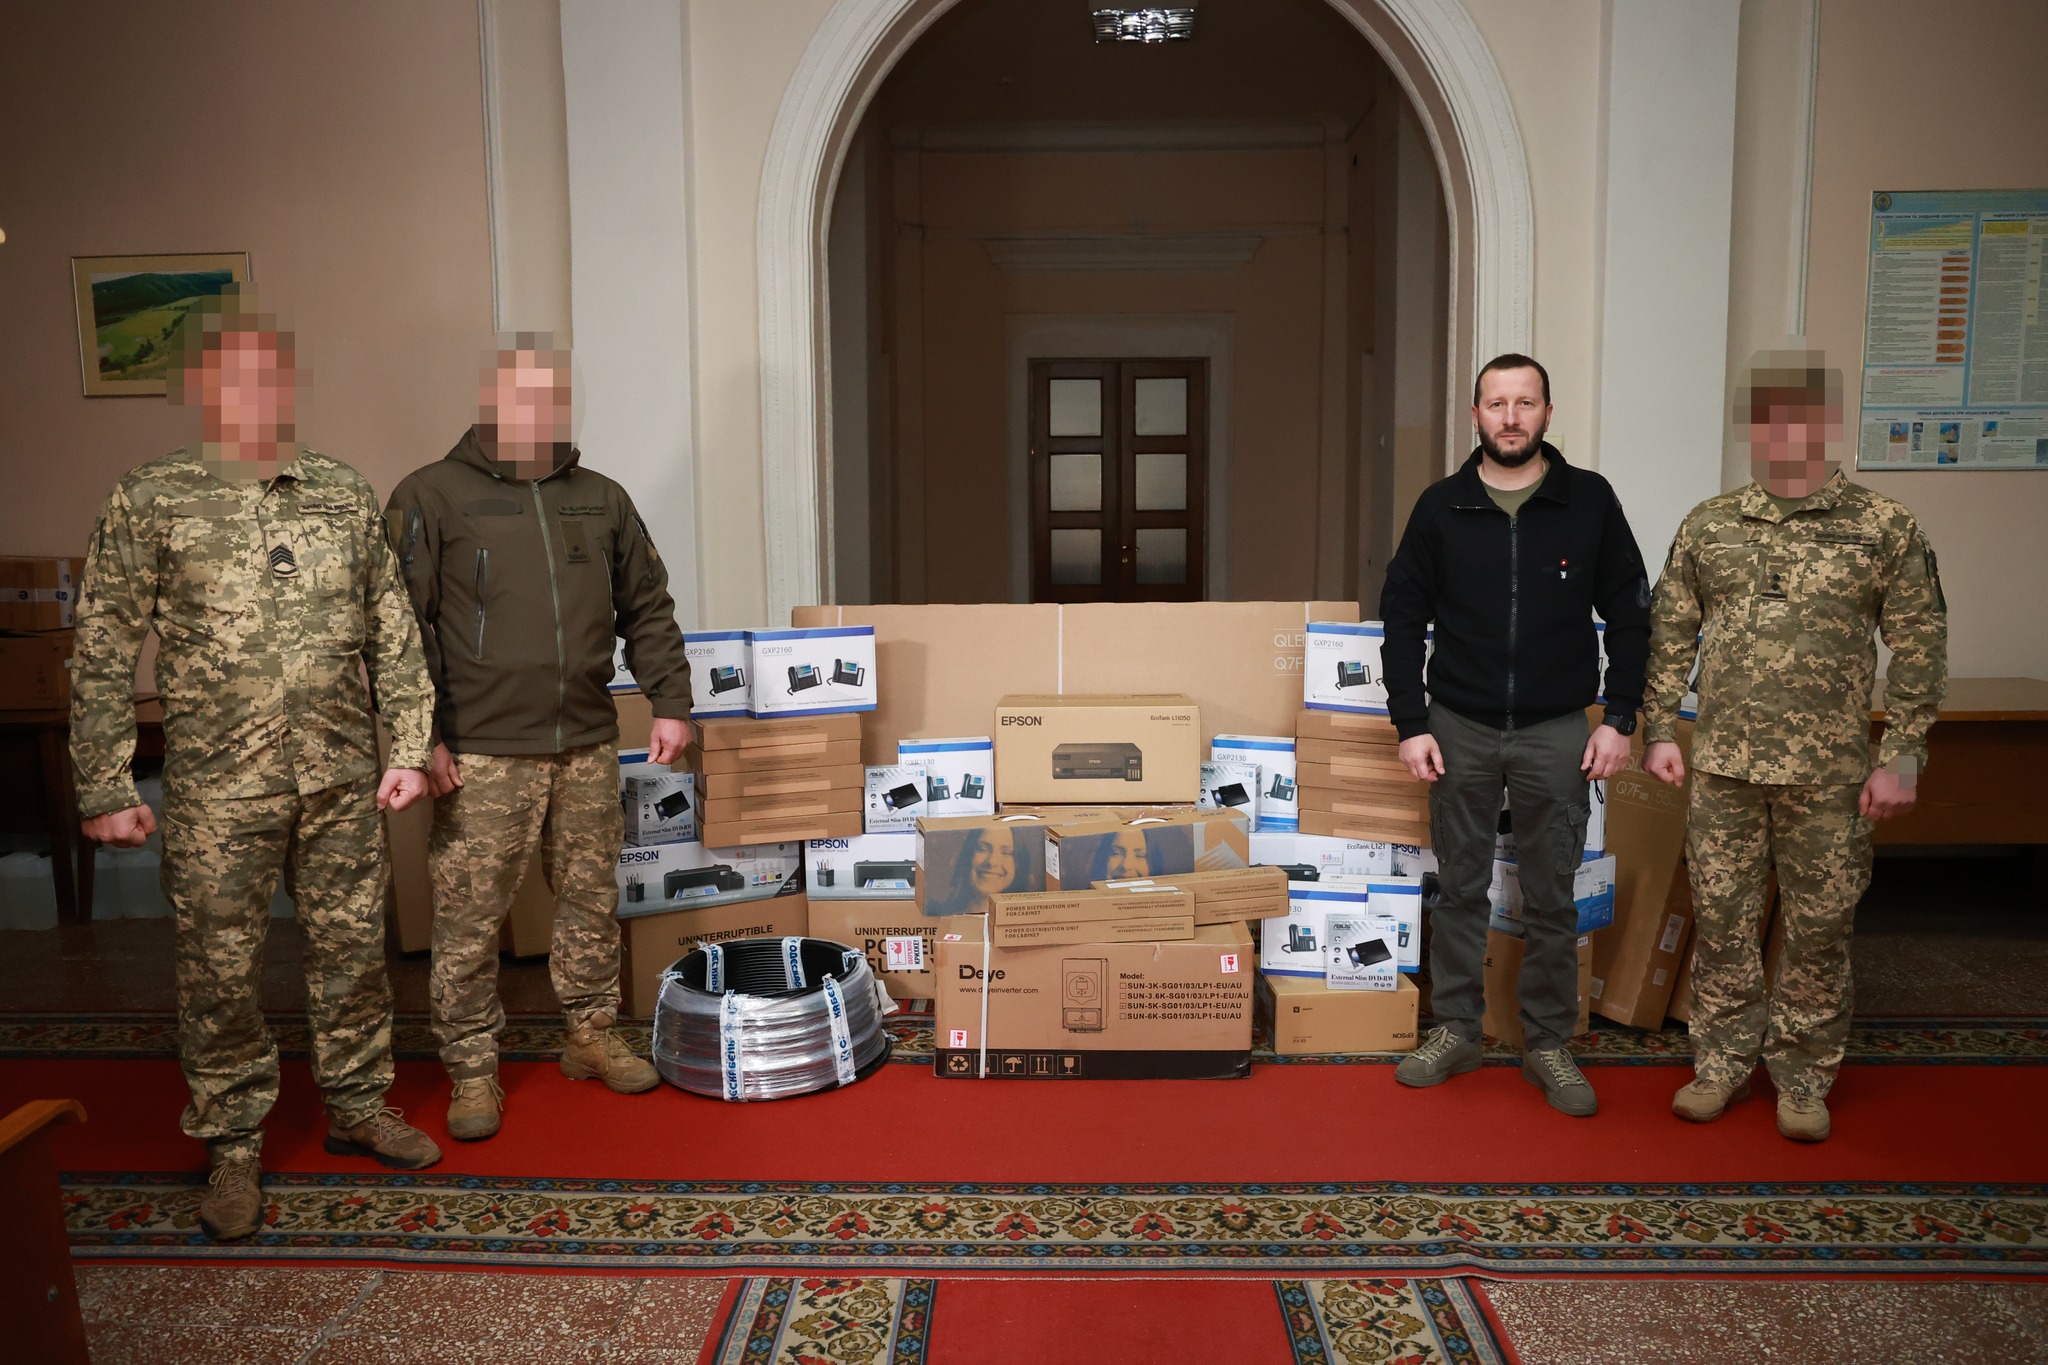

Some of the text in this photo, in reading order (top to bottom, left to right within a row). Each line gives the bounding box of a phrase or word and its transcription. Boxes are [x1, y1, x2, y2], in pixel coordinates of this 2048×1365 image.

[1314, 639, 1344, 648] GXP2160
[762, 646, 793, 655] GXP2160
[1001, 716, 1042, 726] EPSON
[1217, 753, 1247, 762] GXP2130
[810, 839, 849, 849] EPSON
[1391, 843, 1420, 855] EPSON
[620, 850, 659, 864] EPSON
[1027, 903, 1065, 911] DISTRIBUTION
[678, 924, 773, 946] UNINTERRUPTIBLE
[959, 964, 1006, 983] Deye
[959, 986, 1039, 995] www.dyeinverter.com
